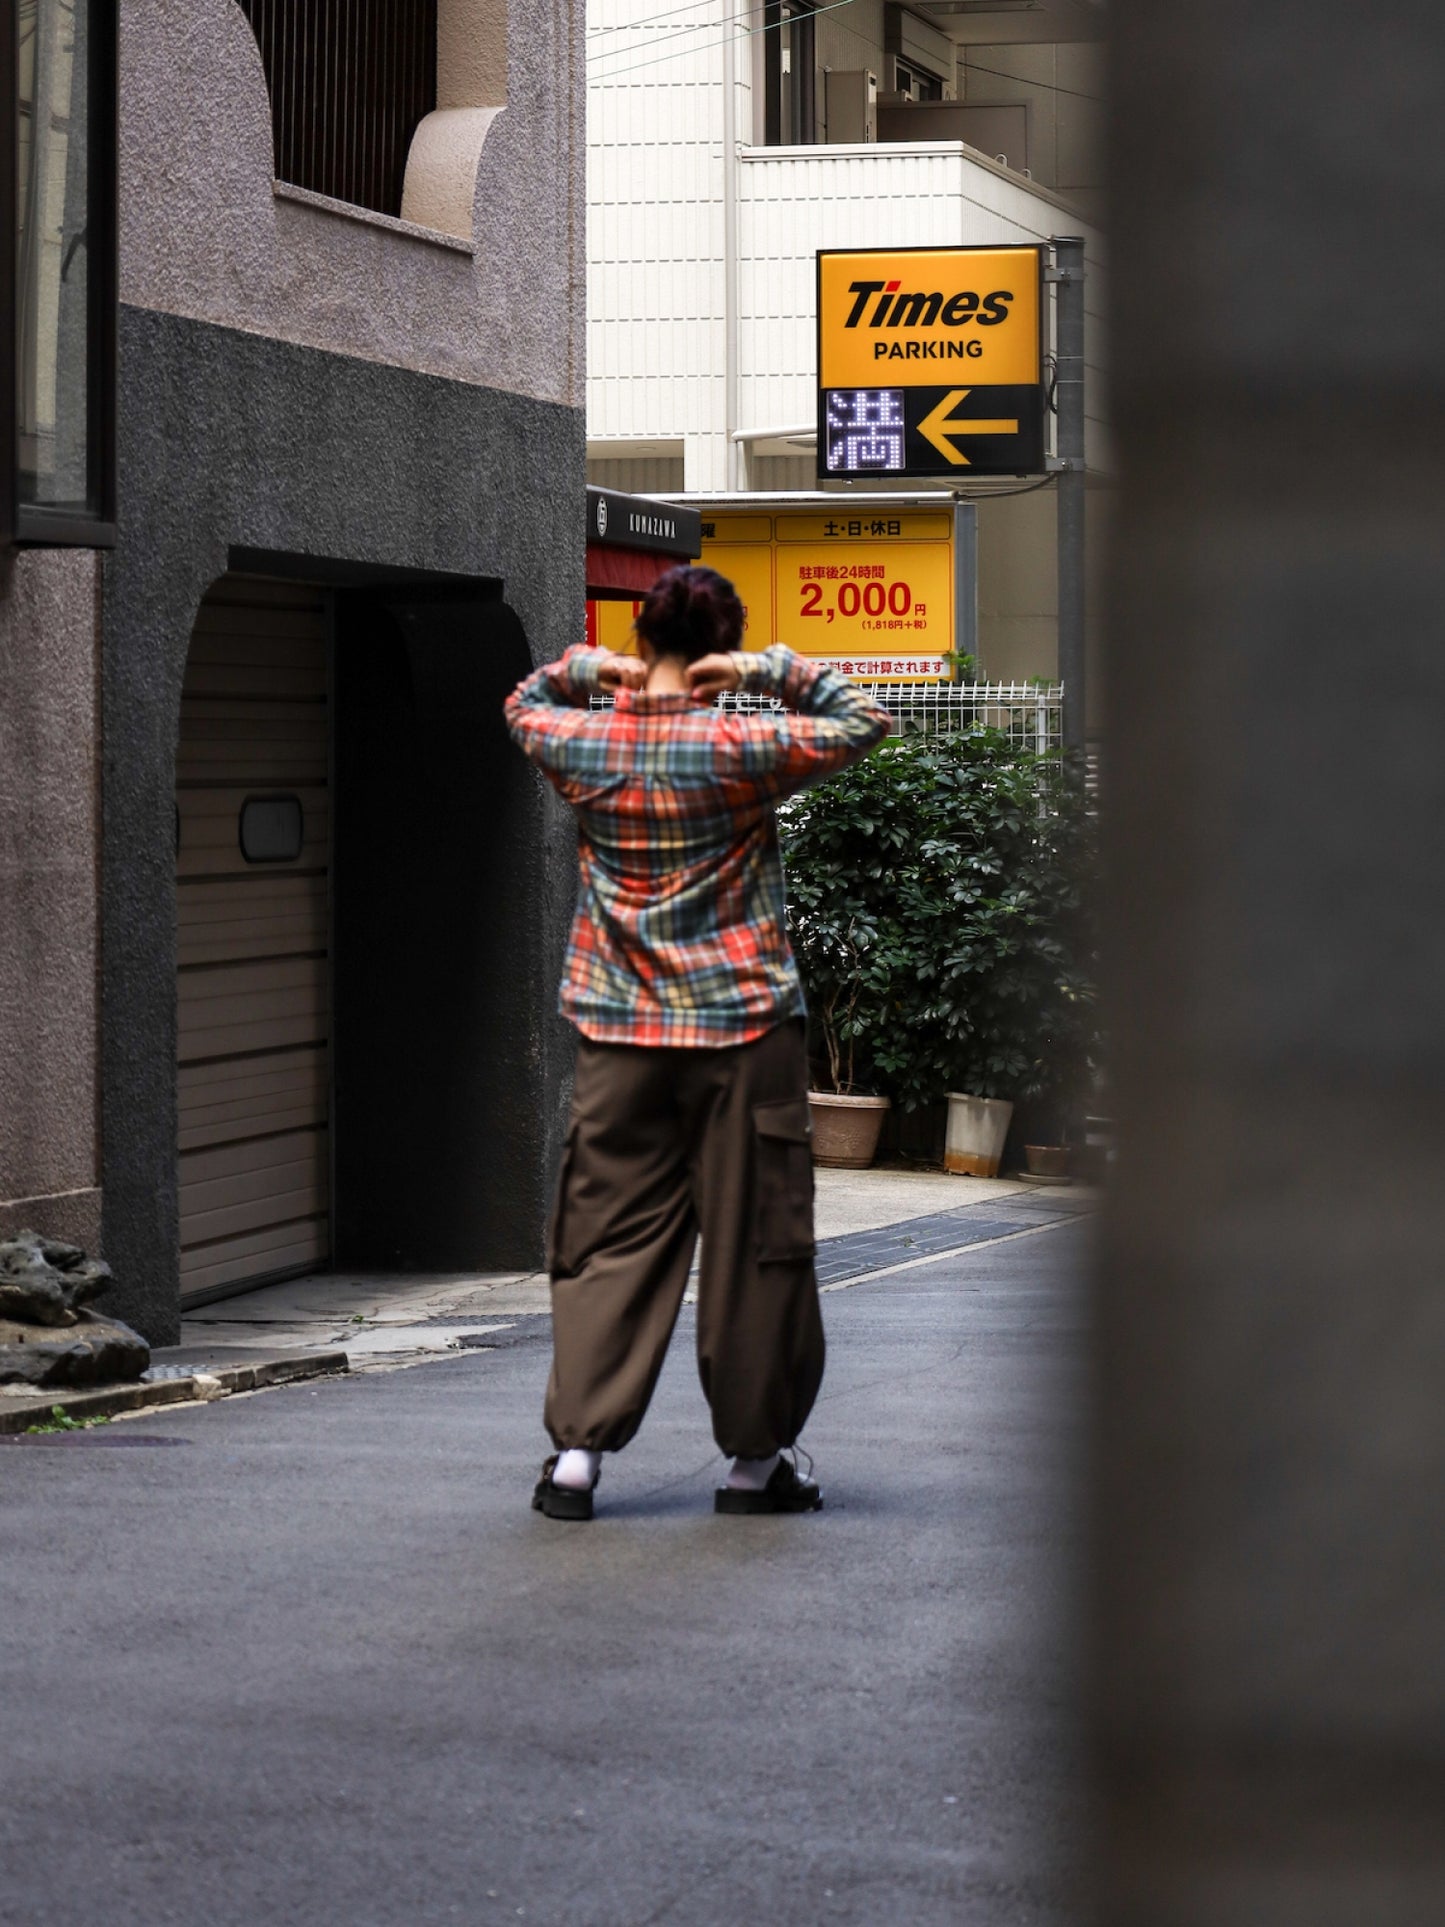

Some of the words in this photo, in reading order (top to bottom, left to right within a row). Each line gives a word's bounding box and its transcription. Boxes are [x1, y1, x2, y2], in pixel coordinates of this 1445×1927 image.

[844, 280, 1014, 329] Times
[873, 340, 983, 360] PARKING
[829, 392, 904, 470] 満
[629, 513, 676, 539] KUMAZAWA
[799, 565, 885, 580] 駐車後24時間
